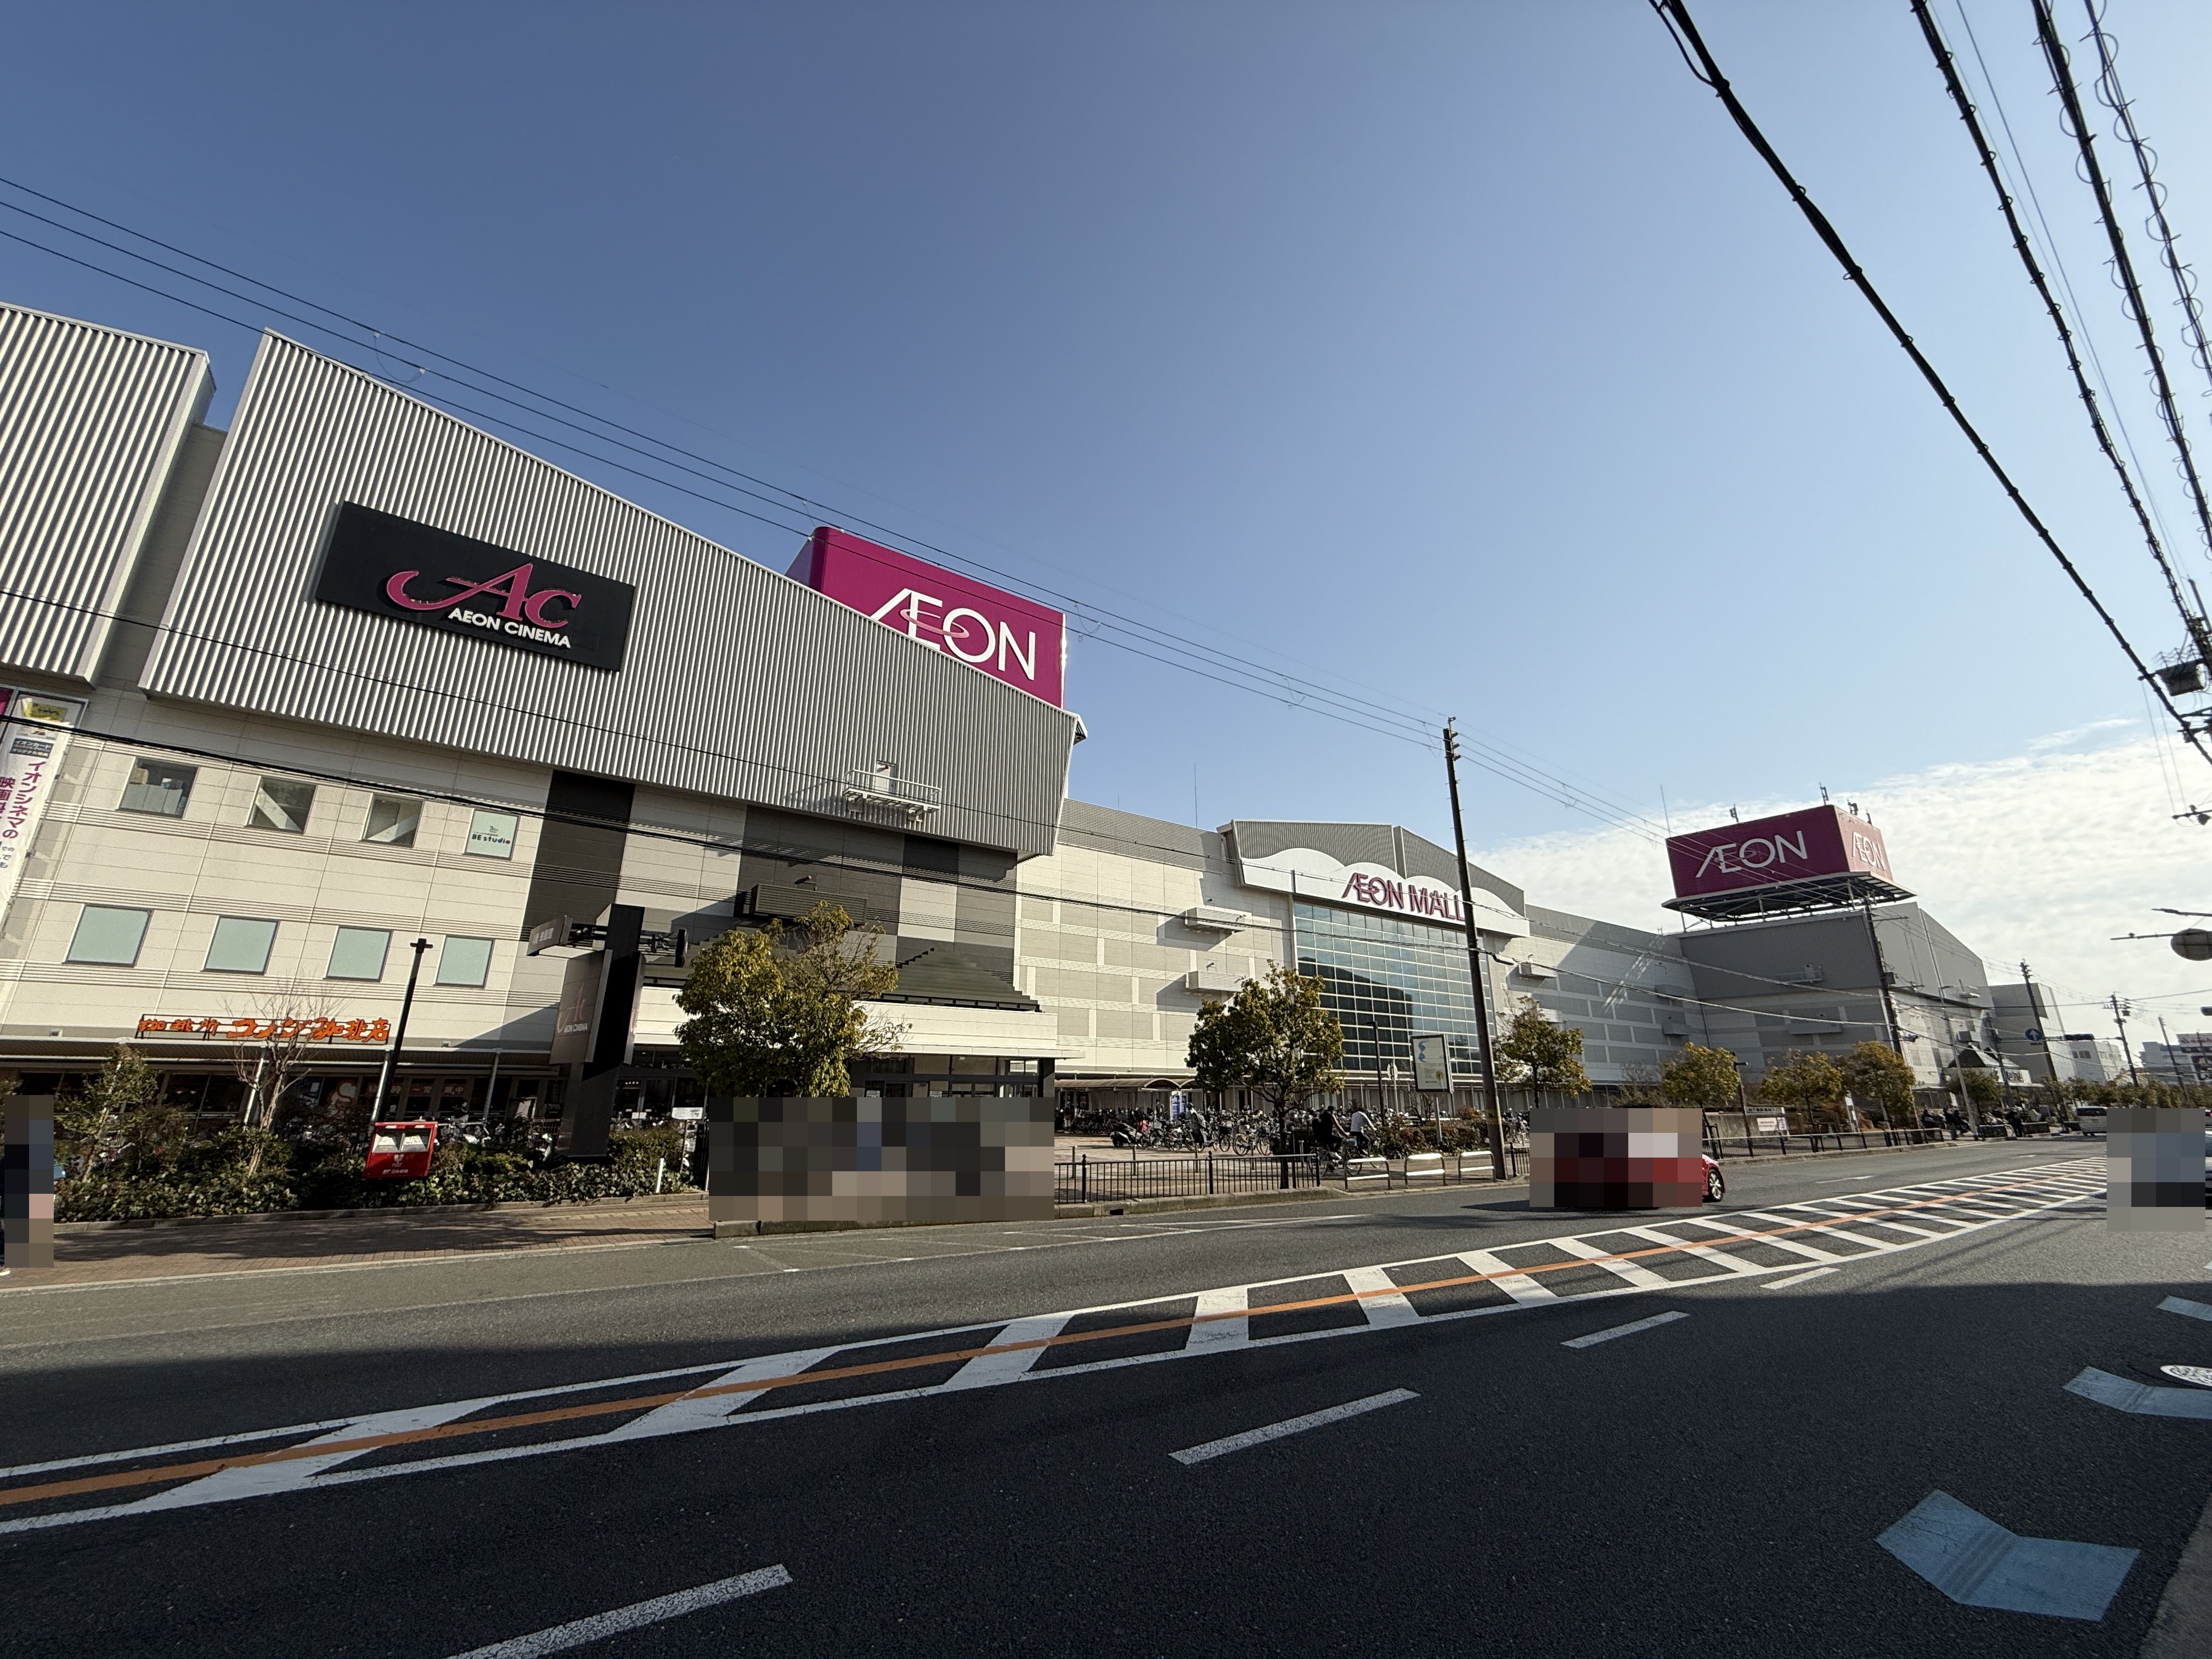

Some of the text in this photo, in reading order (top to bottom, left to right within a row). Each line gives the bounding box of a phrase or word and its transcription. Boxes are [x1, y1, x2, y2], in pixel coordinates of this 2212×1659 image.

[448, 607, 572, 649] AEON CINEMA
[2, 761, 47, 839] イオンシネマの
[1408, 884, 1465, 921] MALL
